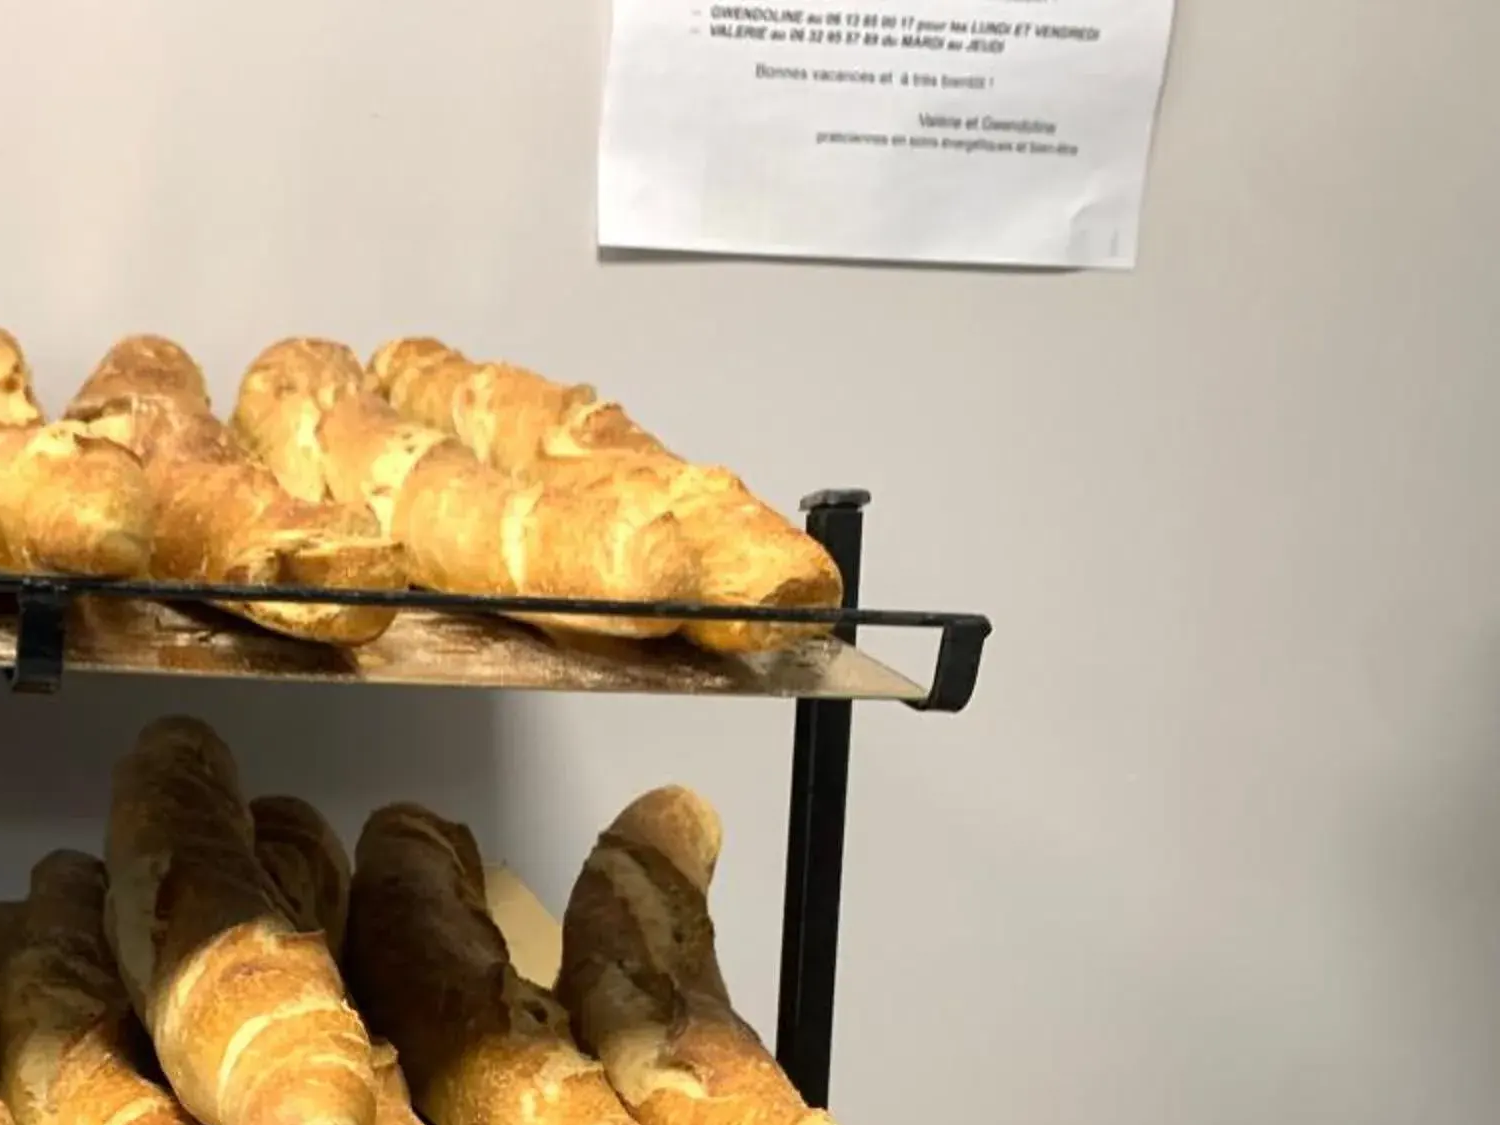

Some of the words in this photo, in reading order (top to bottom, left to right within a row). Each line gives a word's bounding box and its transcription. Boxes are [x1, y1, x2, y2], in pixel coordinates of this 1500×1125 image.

[916, 20, 947, 34] pour
[971, 20, 1011, 35] LUNDI
[1035, 24, 1101, 42] VENDREDI
[901, 34, 944, 51] MARDI
[966, 39, 1006, 54] JEUDI
[755, 62, 807, 80] Bonnes
[813, 69, 875, 85] vacances
[879, 71, 893, 85] et
[965, 116, 979, 130] et
[982, 116, 1056, 134] Gwendoline
